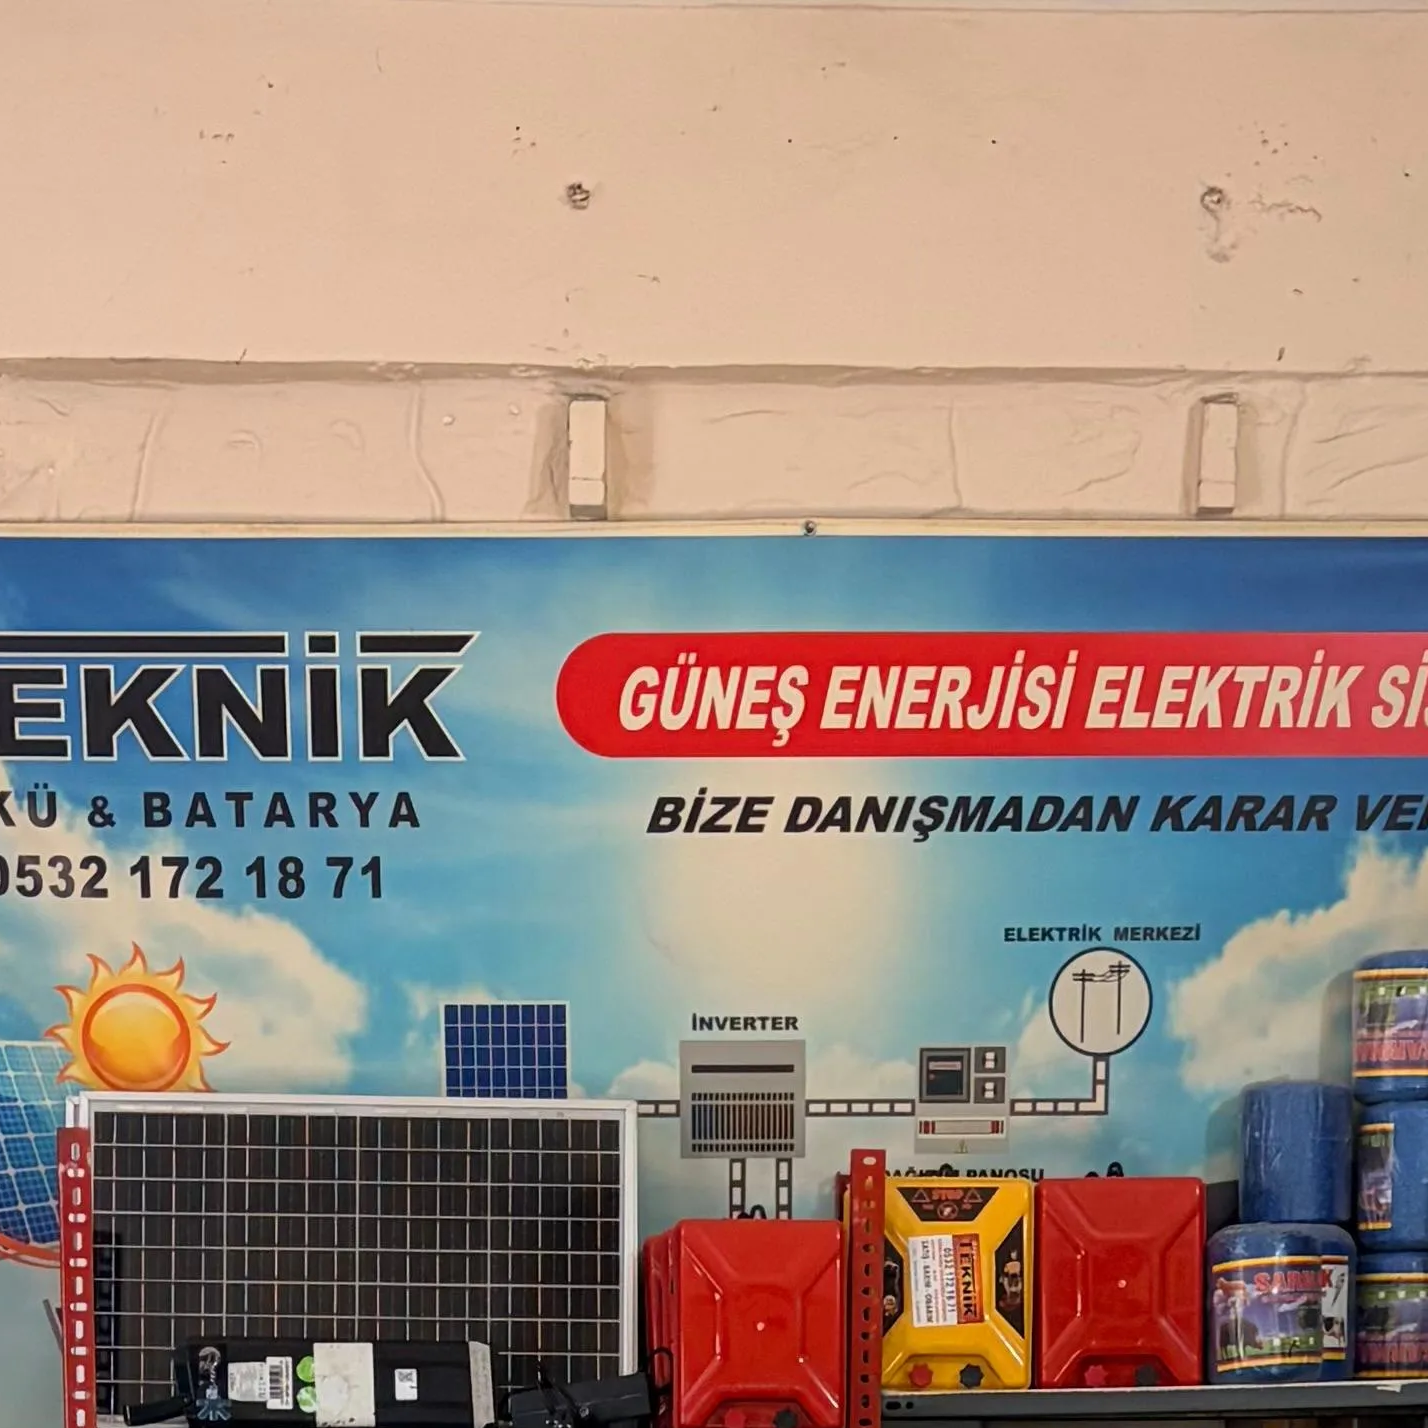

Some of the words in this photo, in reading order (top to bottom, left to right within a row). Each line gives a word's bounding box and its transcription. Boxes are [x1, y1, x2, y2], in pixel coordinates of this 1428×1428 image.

[618, 652, 808, 747] GÜNEŞ
[819, 649, 1079, 731] ENERJİSİ
[1084, 649, 1364, 730] ELEKTRİK
[87, 795, 117, 828] &
[143, 791, 421, 828] BATARYA
[646, 788, 776, 833] BİZE
[783, 796, 1140, 843] DANIŞMADAN
[1149, 795, 1338, 833] KARAR
[129, 855, 225, 899] 172
[245, 856, 306, 899] 18
[327, 855, 384, 899] 71
[1004, 924, 1102, 942] ELEKTRİK
[1114, 923, 1201, 941] MERKEZİ
[692, 1012, 800, 1031] İNVERTER
[959, 1239, 977, 1317] TEKNİK
